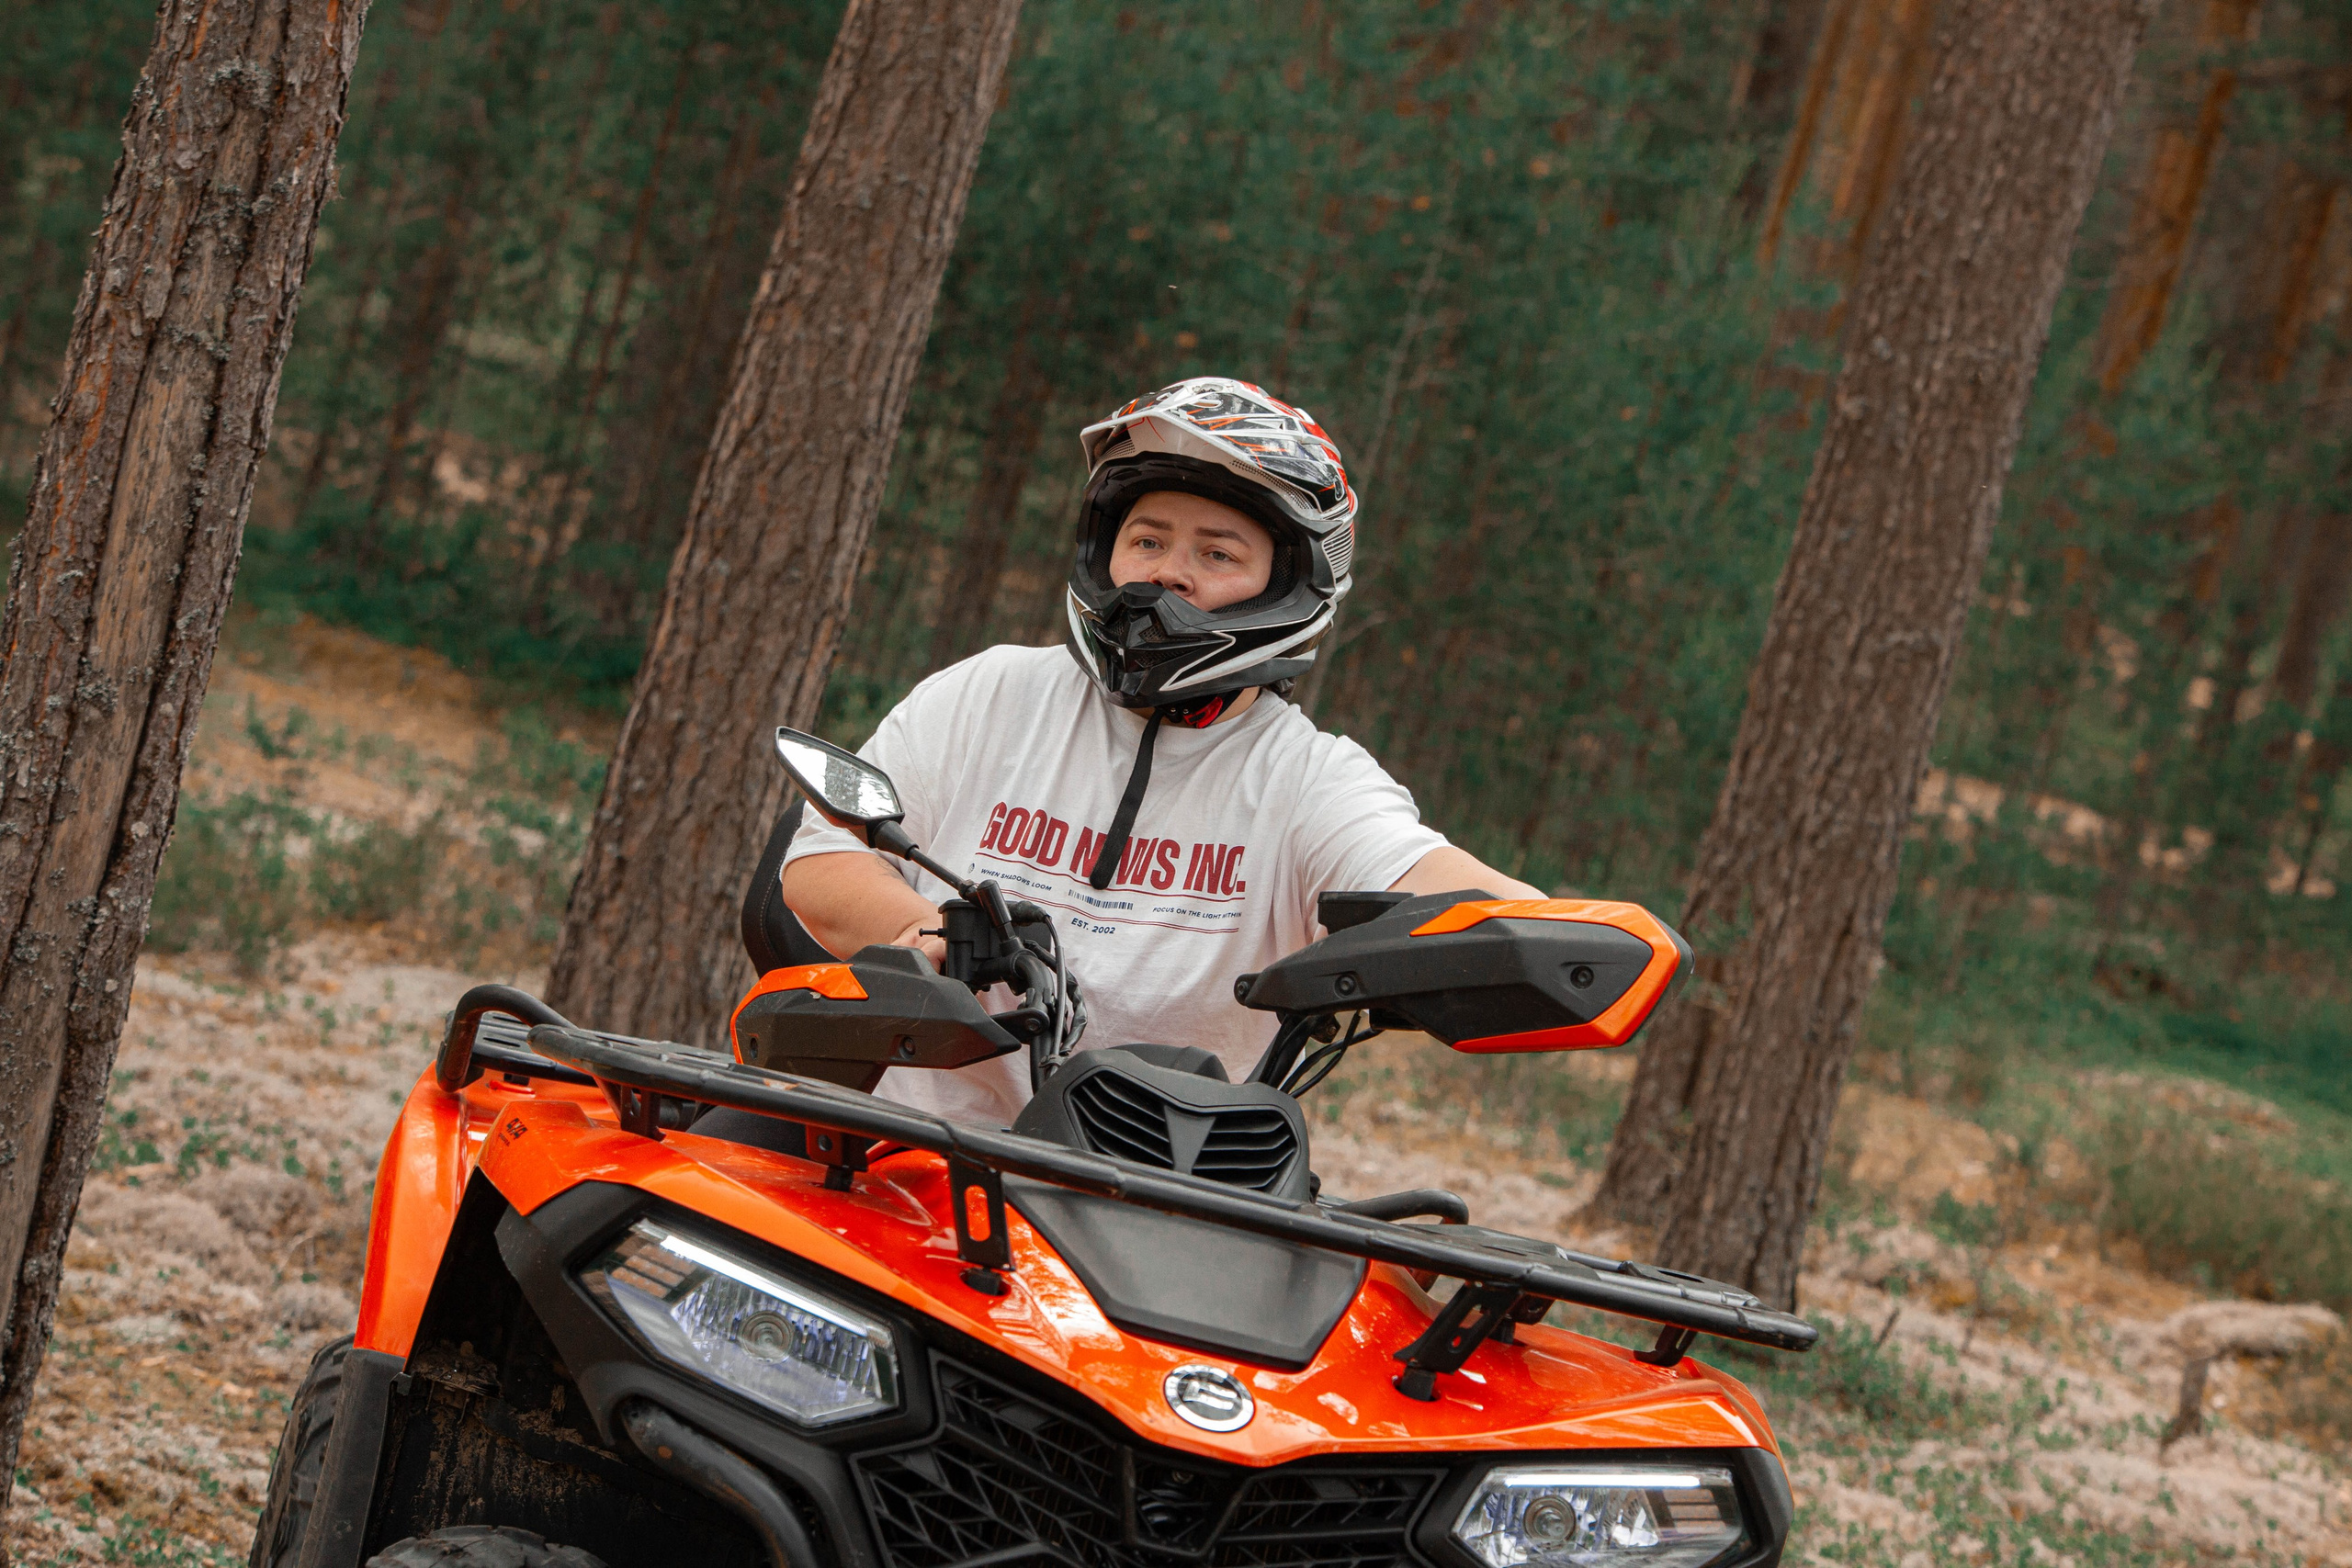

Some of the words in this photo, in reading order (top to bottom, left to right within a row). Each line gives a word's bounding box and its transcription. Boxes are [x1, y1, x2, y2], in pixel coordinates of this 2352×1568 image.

[979, 801, 1069, 867] GOOD
[1069, 826, 1181, 890] NWS
[1182, 843, 1246, 896] INC.
[980, 868, 1000, 877] WHEN
[1001, 874, 1030, 886] SHADOWS
[1031, 882, 1052, 891] LOOM
[1202, 911, 1221, 919] LIGHT
[1070, 918, 1089, 931] EST.
[1091, 925, 1116, 935] 2002
